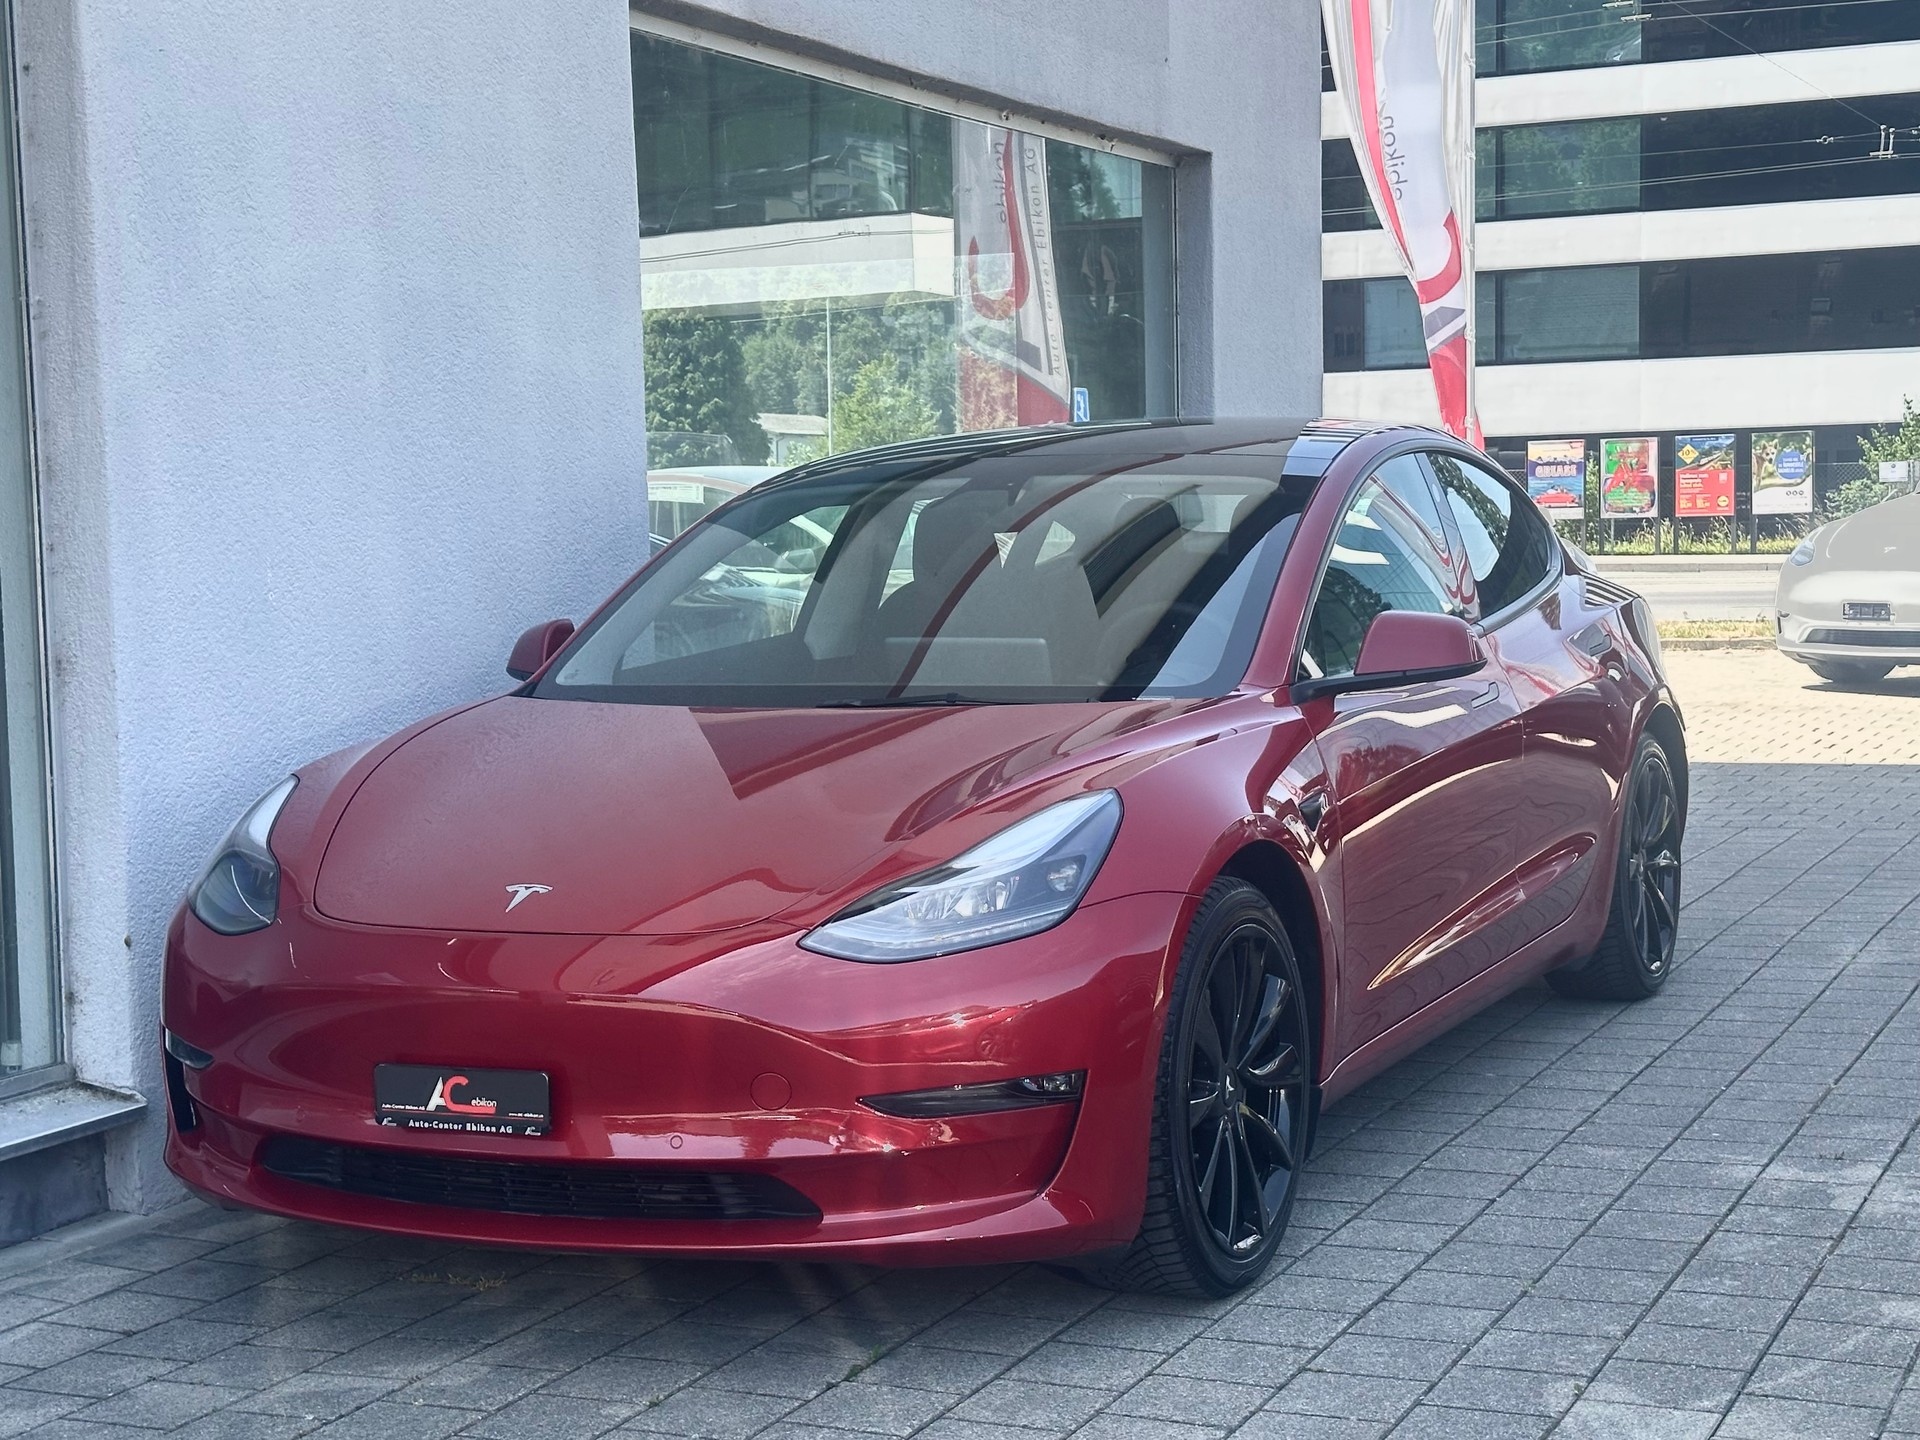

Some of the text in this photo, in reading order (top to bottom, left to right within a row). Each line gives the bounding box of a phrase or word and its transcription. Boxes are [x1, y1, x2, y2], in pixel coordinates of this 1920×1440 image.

[1024, 147, 1038, 175] AG
[1030, 184, 1047, 249] Ebikon
[1049, 334, 1061, 376] Auto
[471, 1097, 497, 1107] ebikon
[408, 1119, 513, 1134] Auto-Center Ebikon AG
